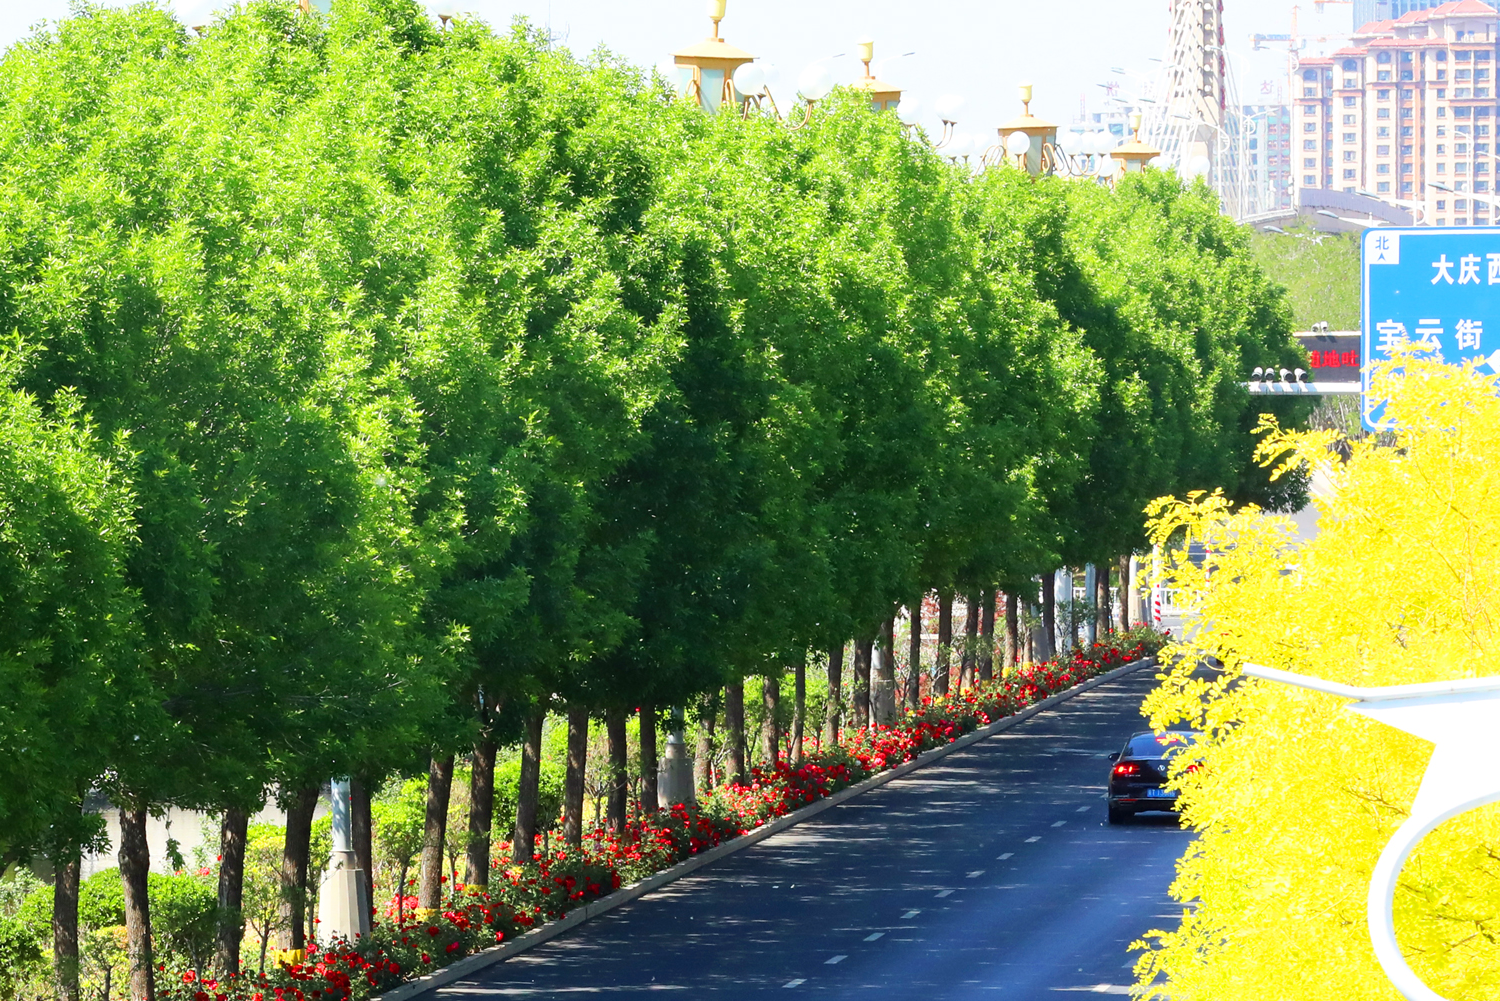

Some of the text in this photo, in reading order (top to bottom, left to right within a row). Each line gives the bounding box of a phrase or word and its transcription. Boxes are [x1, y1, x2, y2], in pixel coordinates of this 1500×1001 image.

[1375, 236, 1390, 250] 北
[1375, 319, 1483, 351] 宝云街
